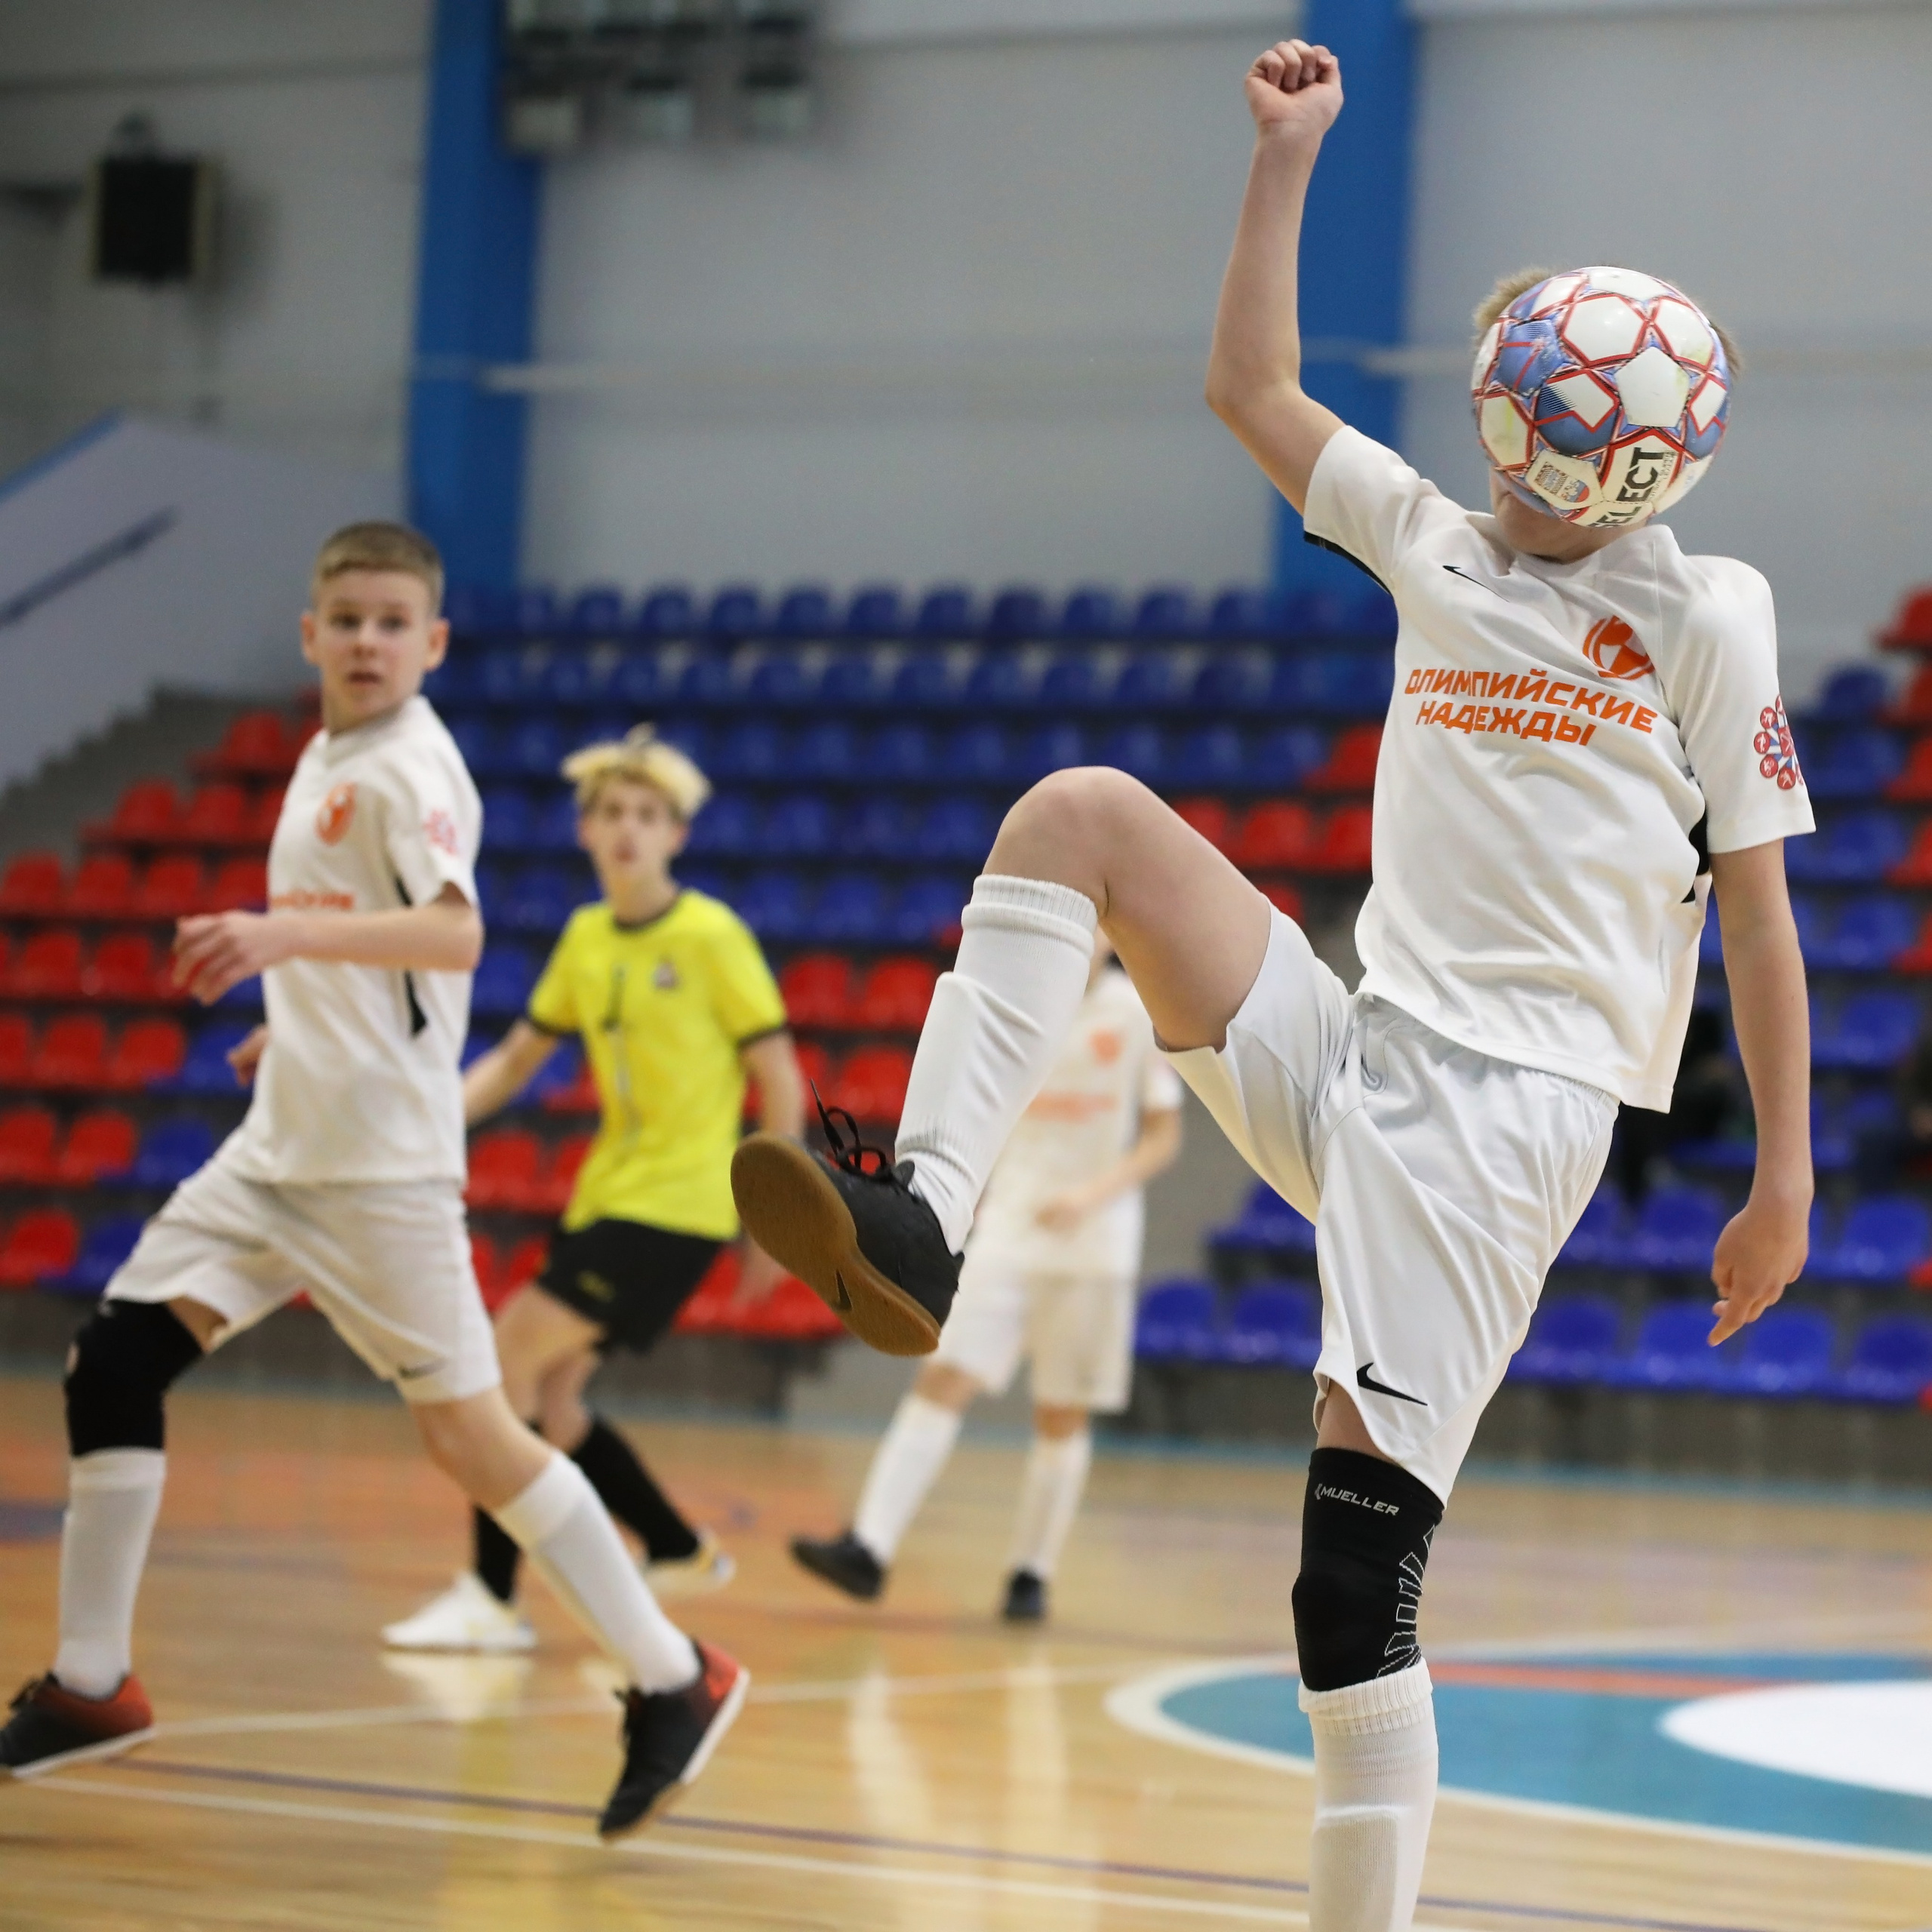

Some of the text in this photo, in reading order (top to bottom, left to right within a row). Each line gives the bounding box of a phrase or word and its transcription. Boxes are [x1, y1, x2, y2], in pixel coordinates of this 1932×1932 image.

[1404, 668, 1658, 734] ОЛИМПИЙСКИЕ
[1415, 700, 1598, 746] НАДЕЖДЫ
[1320, 1485, 1400, 1516] MUELLER
